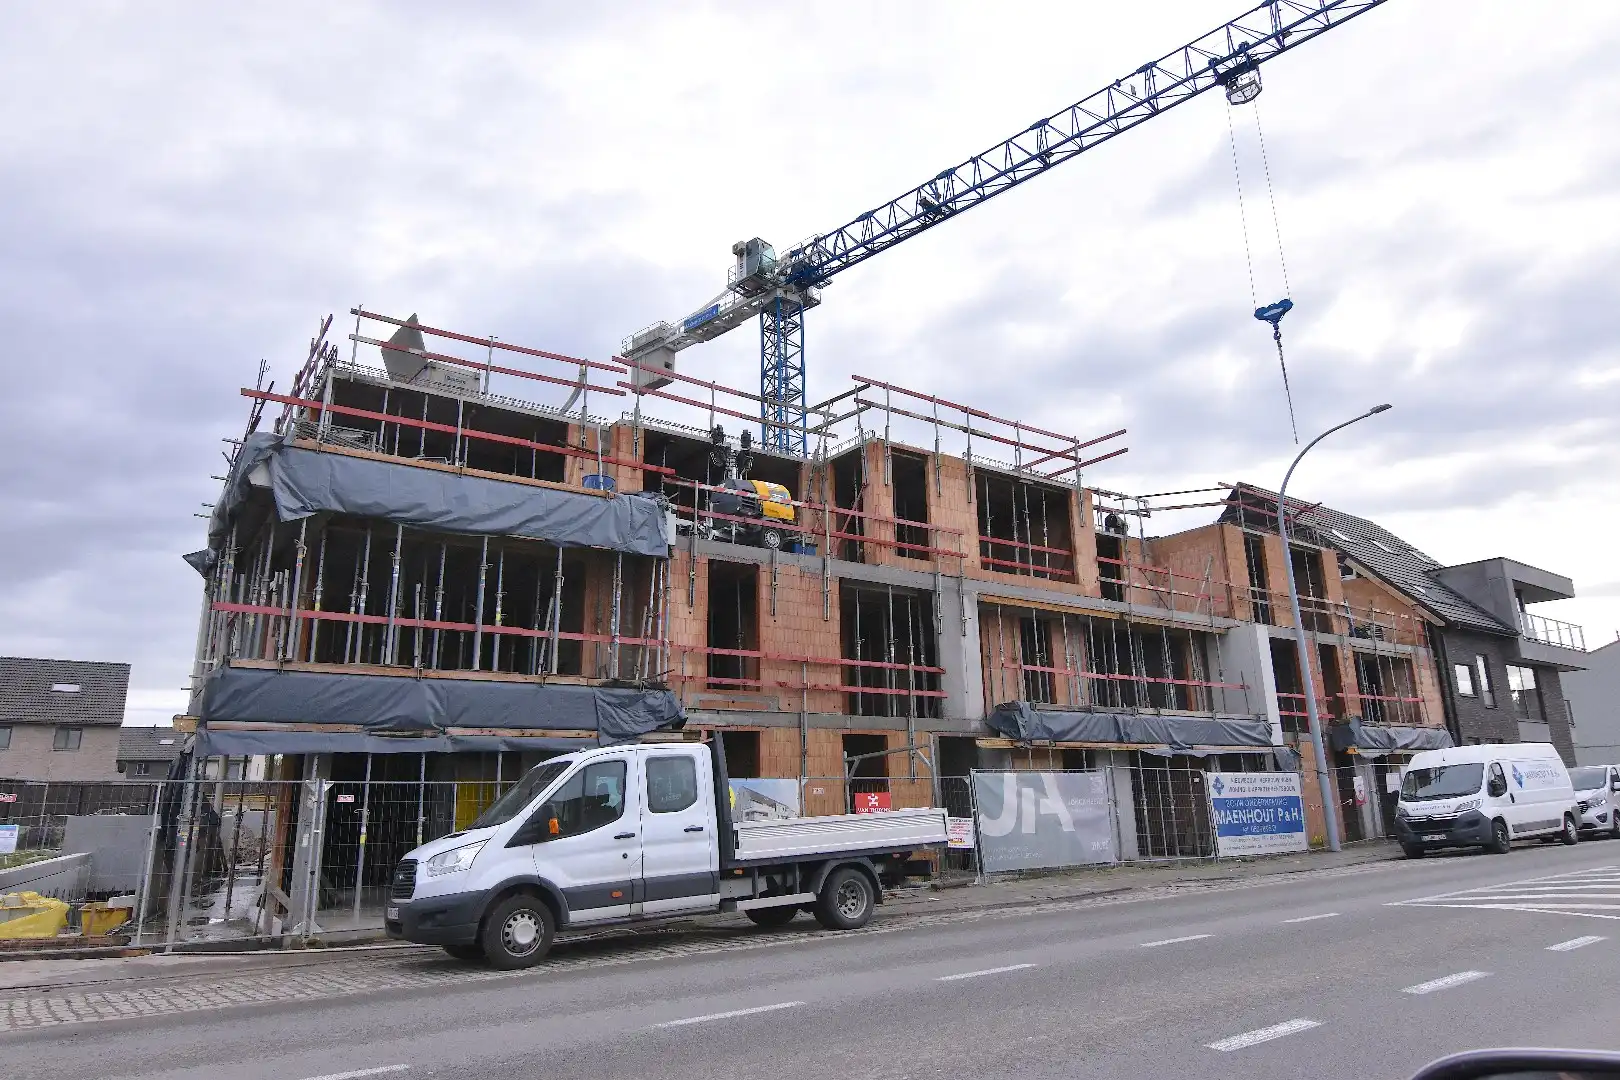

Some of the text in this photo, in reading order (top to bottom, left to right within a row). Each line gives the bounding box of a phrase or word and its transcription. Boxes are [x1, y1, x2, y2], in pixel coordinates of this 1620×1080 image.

[1214, 808, 1275, 825] MAENHOUT
[1278, 808, 1284, 822] P
[1285, 811, 1291, 822] &
